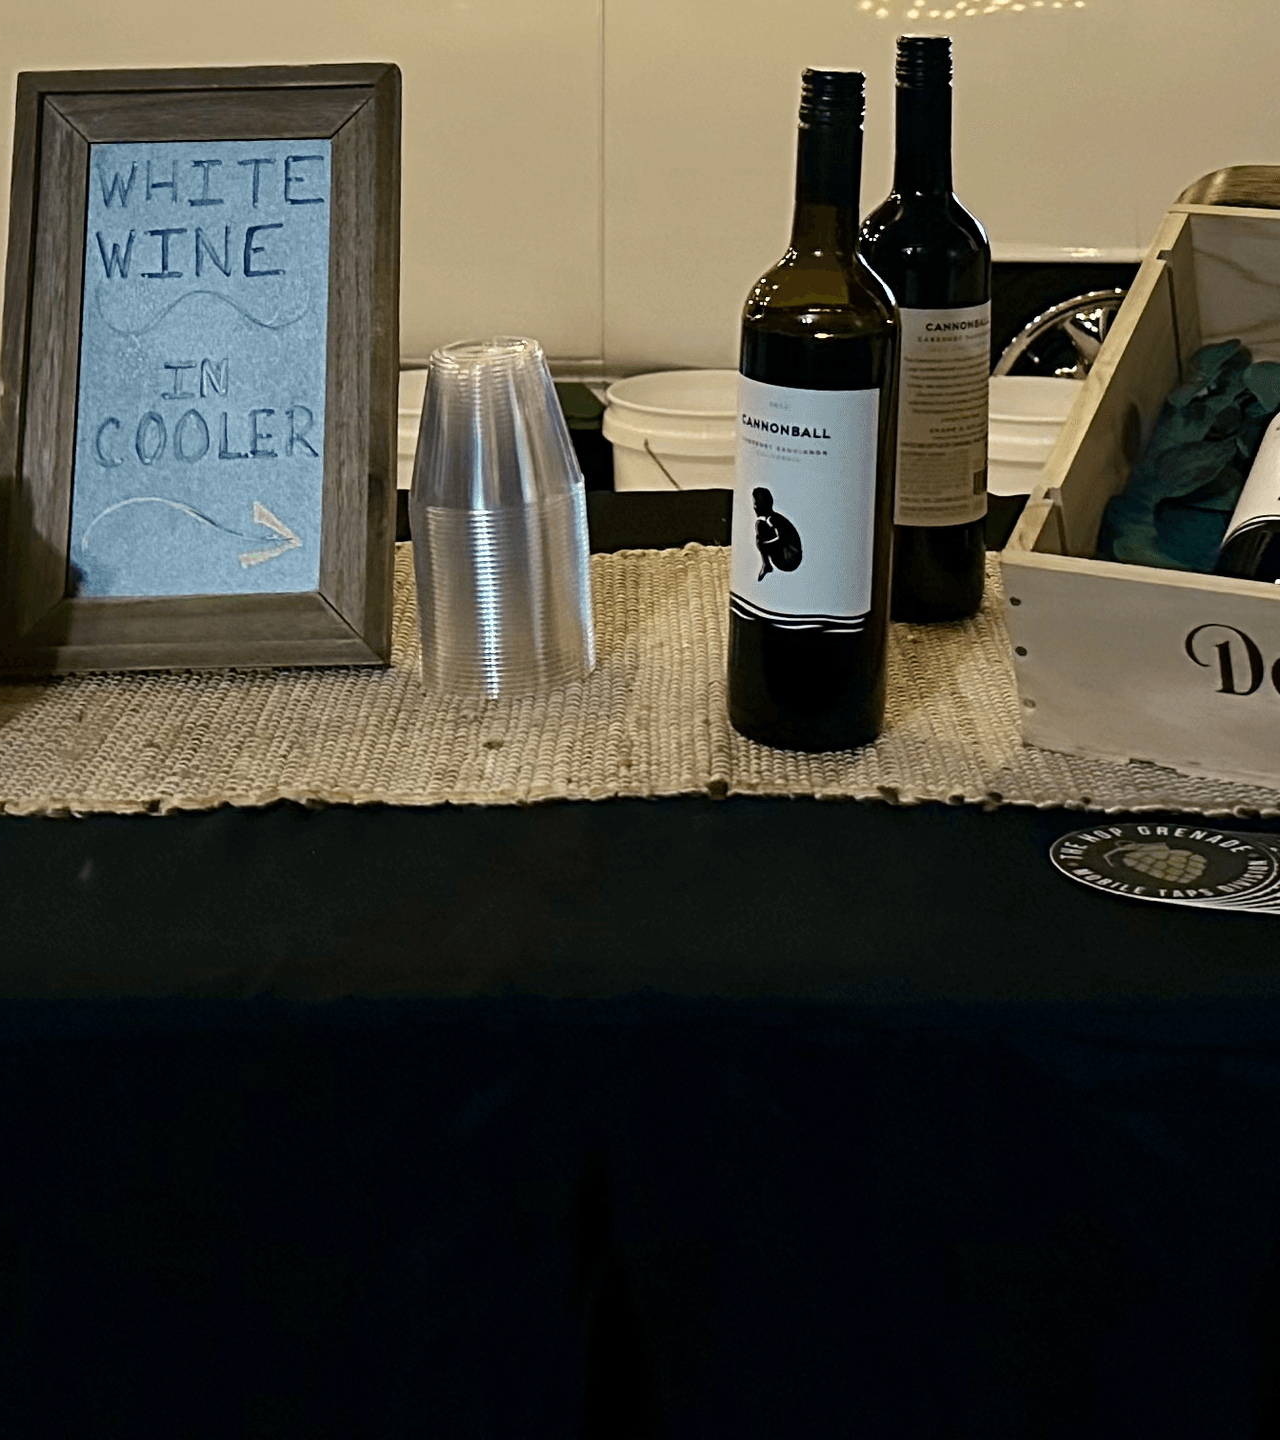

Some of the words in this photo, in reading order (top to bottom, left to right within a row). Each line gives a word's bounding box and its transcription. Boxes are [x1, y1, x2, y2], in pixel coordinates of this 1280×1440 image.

[95, 154, 326, 208] WHITE
[95, 222, 286, 279] WINE
[161, 358, 231, 400] IN
[94, 405, 320, 468] COOLER
[742, 413, 831, 439] CANNONBALL
[1059, 841, 1089, 860] THE
[1077, 827, 1123, 844] HOP
[1136, 825, 1254, 854] GRENADE
[1071, 868, 1147, 895] MOBILE
[1158, 888, 1215, 898] TAPS
